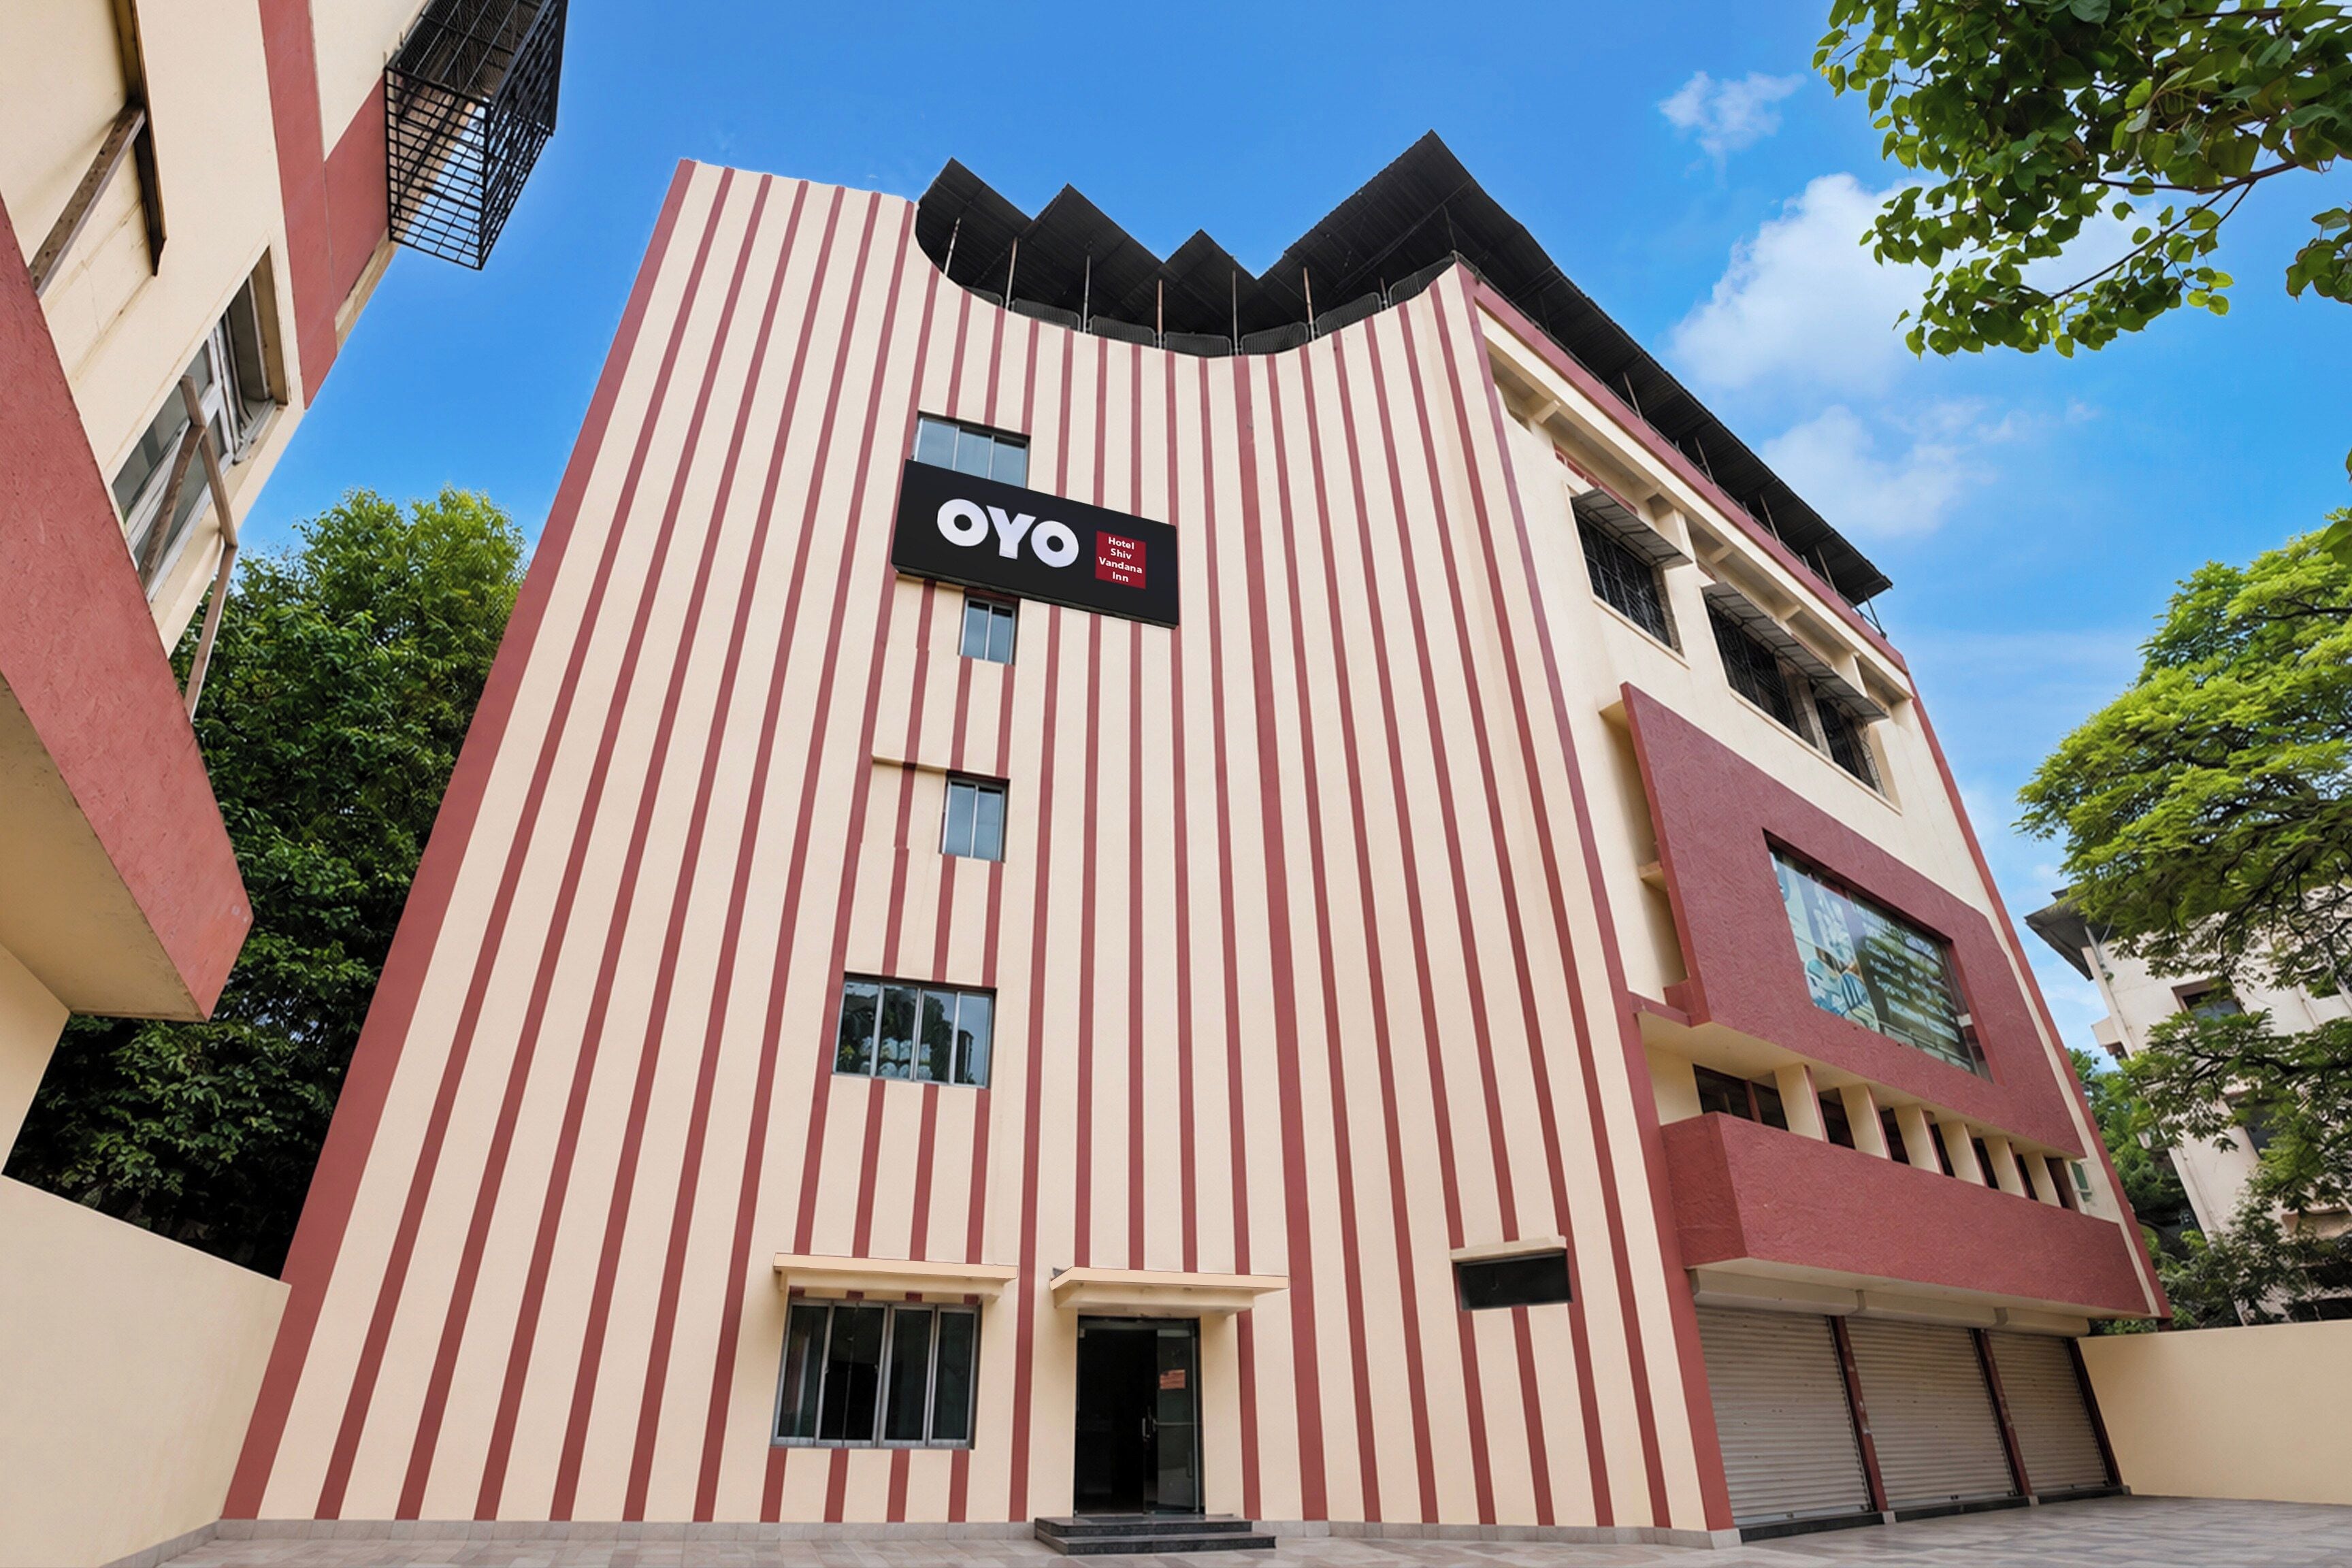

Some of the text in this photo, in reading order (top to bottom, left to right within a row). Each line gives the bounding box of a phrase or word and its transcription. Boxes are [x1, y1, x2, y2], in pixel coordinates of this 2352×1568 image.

[937, 498, 1079, 568] OYO
[1108, 536, 1134, 550] Hotel
[1110, 548, 1132, 559] Shiv
[1098, 556, 1143, 574] Vandana
[1112, 571, 1129, 582] Inn
